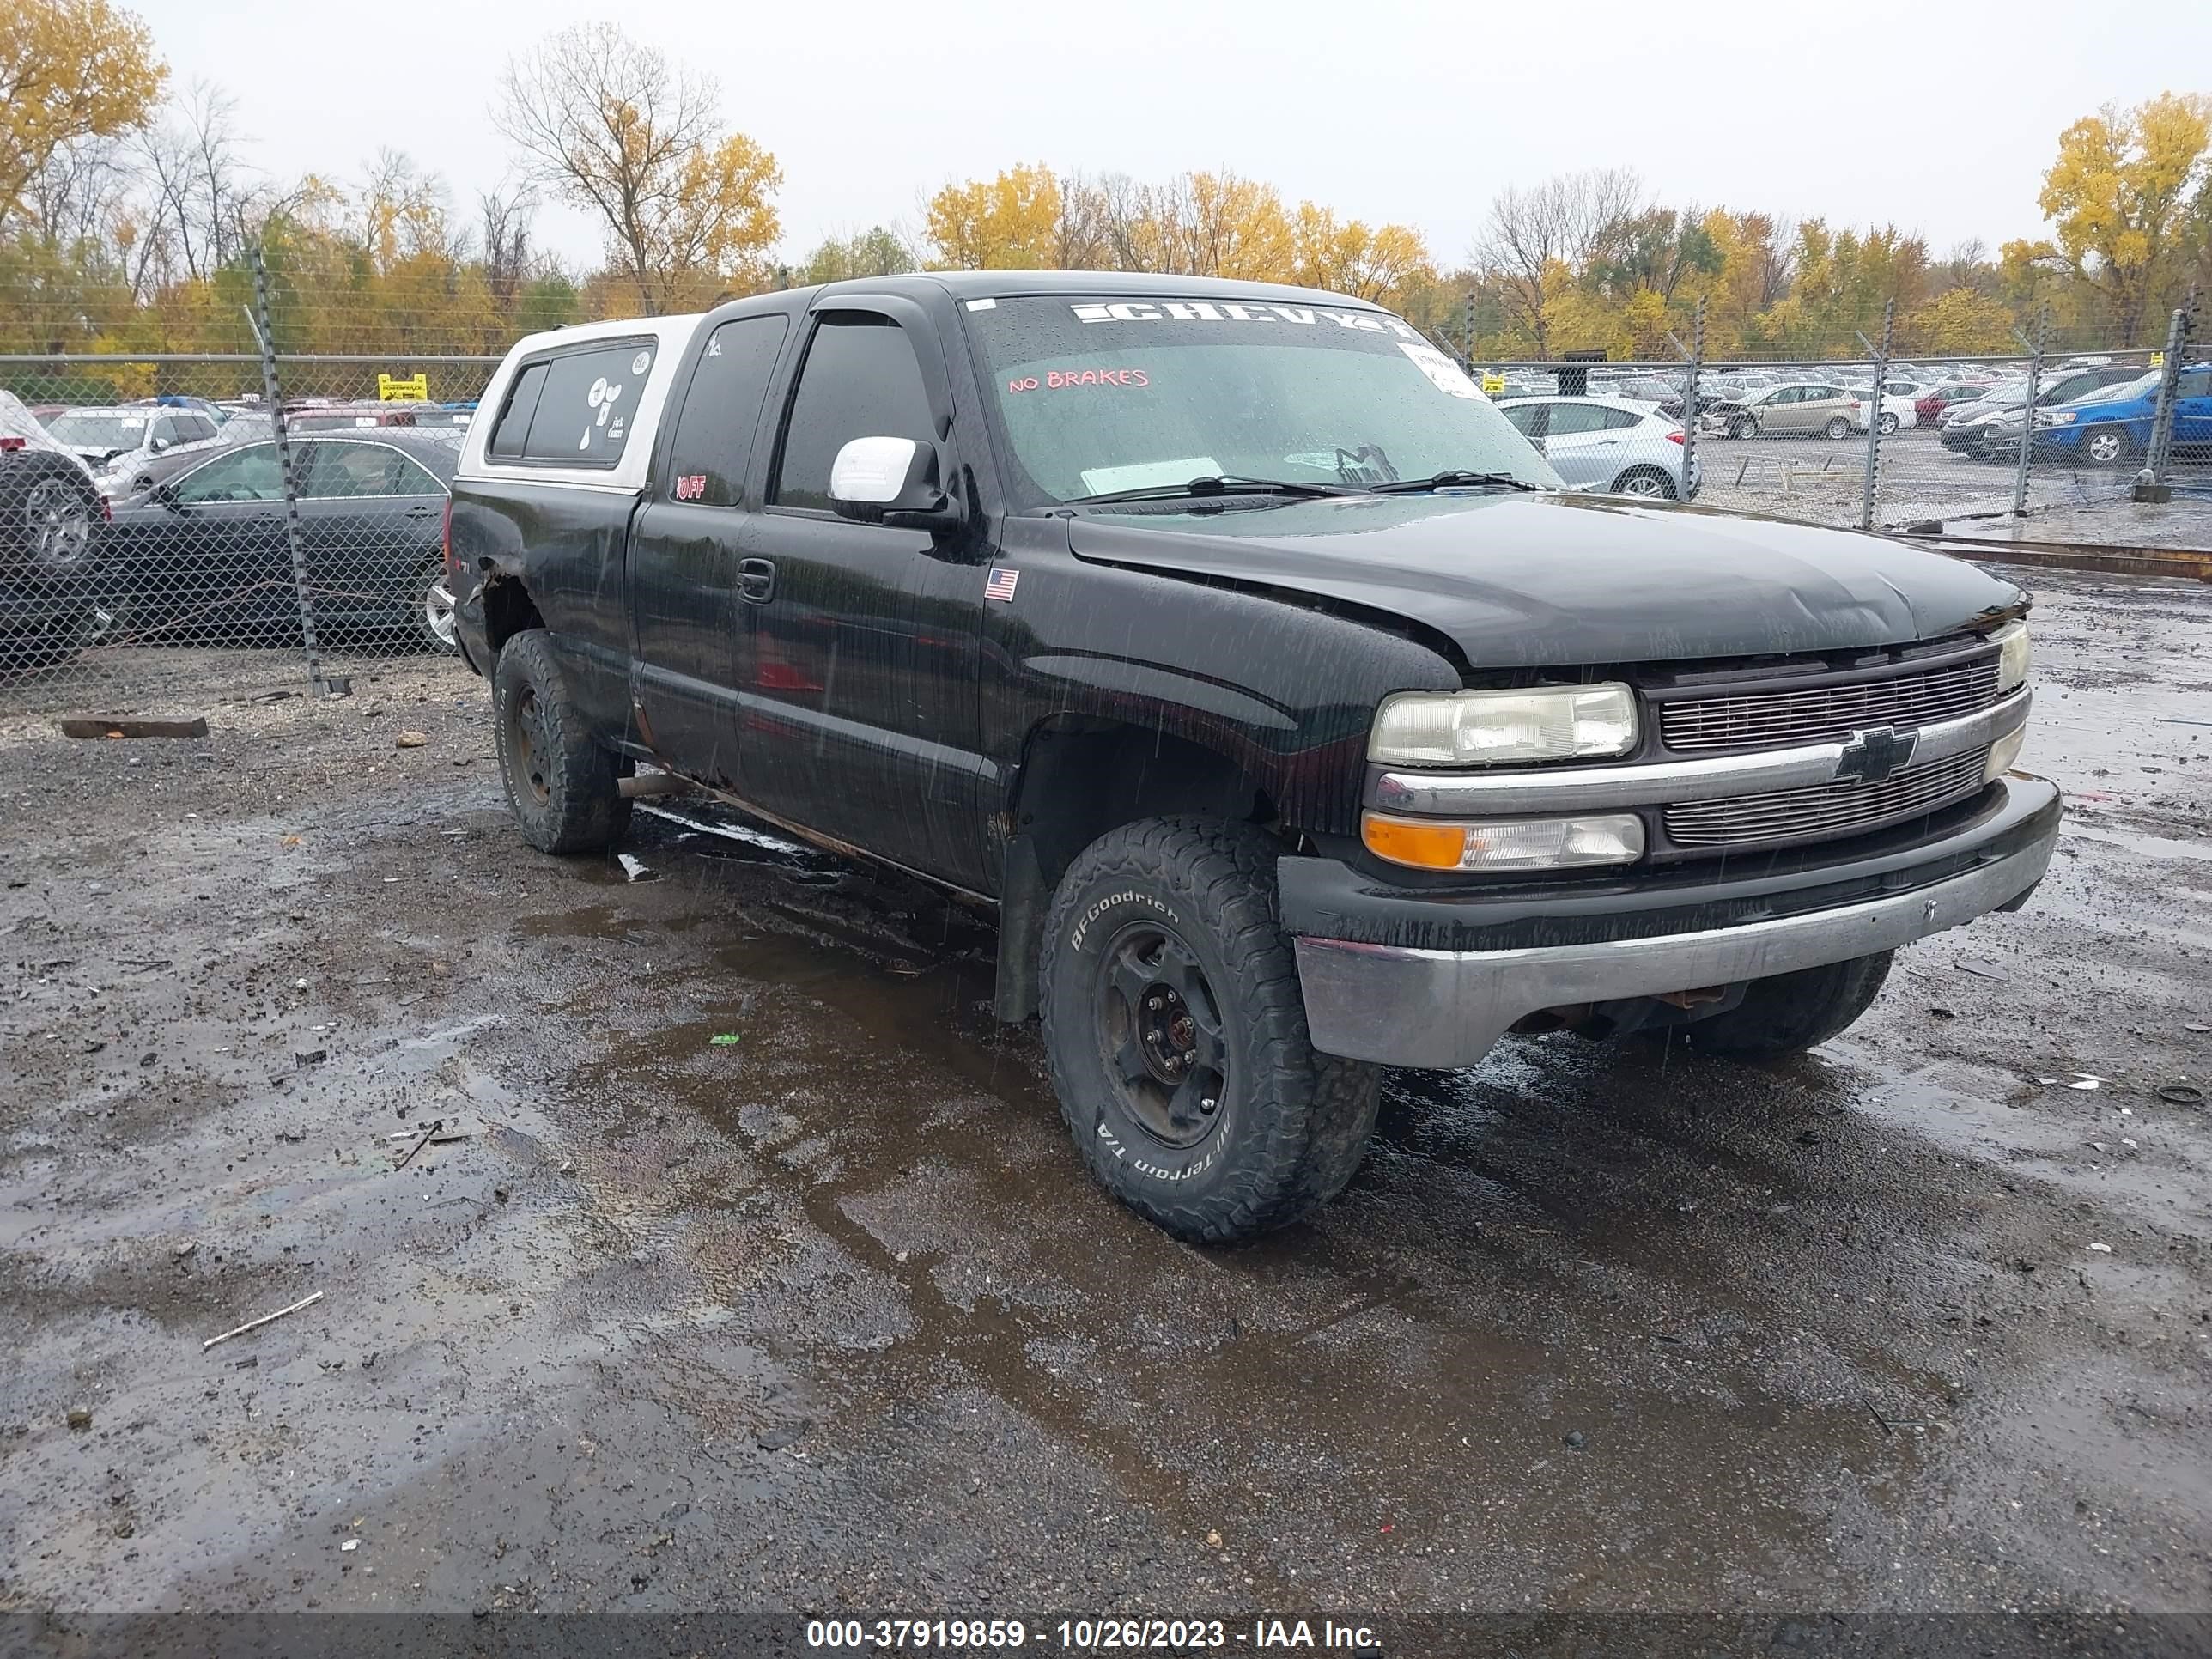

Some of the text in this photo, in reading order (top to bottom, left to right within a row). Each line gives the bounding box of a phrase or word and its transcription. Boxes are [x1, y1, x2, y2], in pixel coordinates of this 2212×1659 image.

[1109, 302, 1355, 328] CHEVY
[1009, 369, 1149, 394] NO BRAKES
[1071, 890, 1179, 952] BFGoodrich
[1097, 1111, 1231, 1181] All-Terrain T/A
